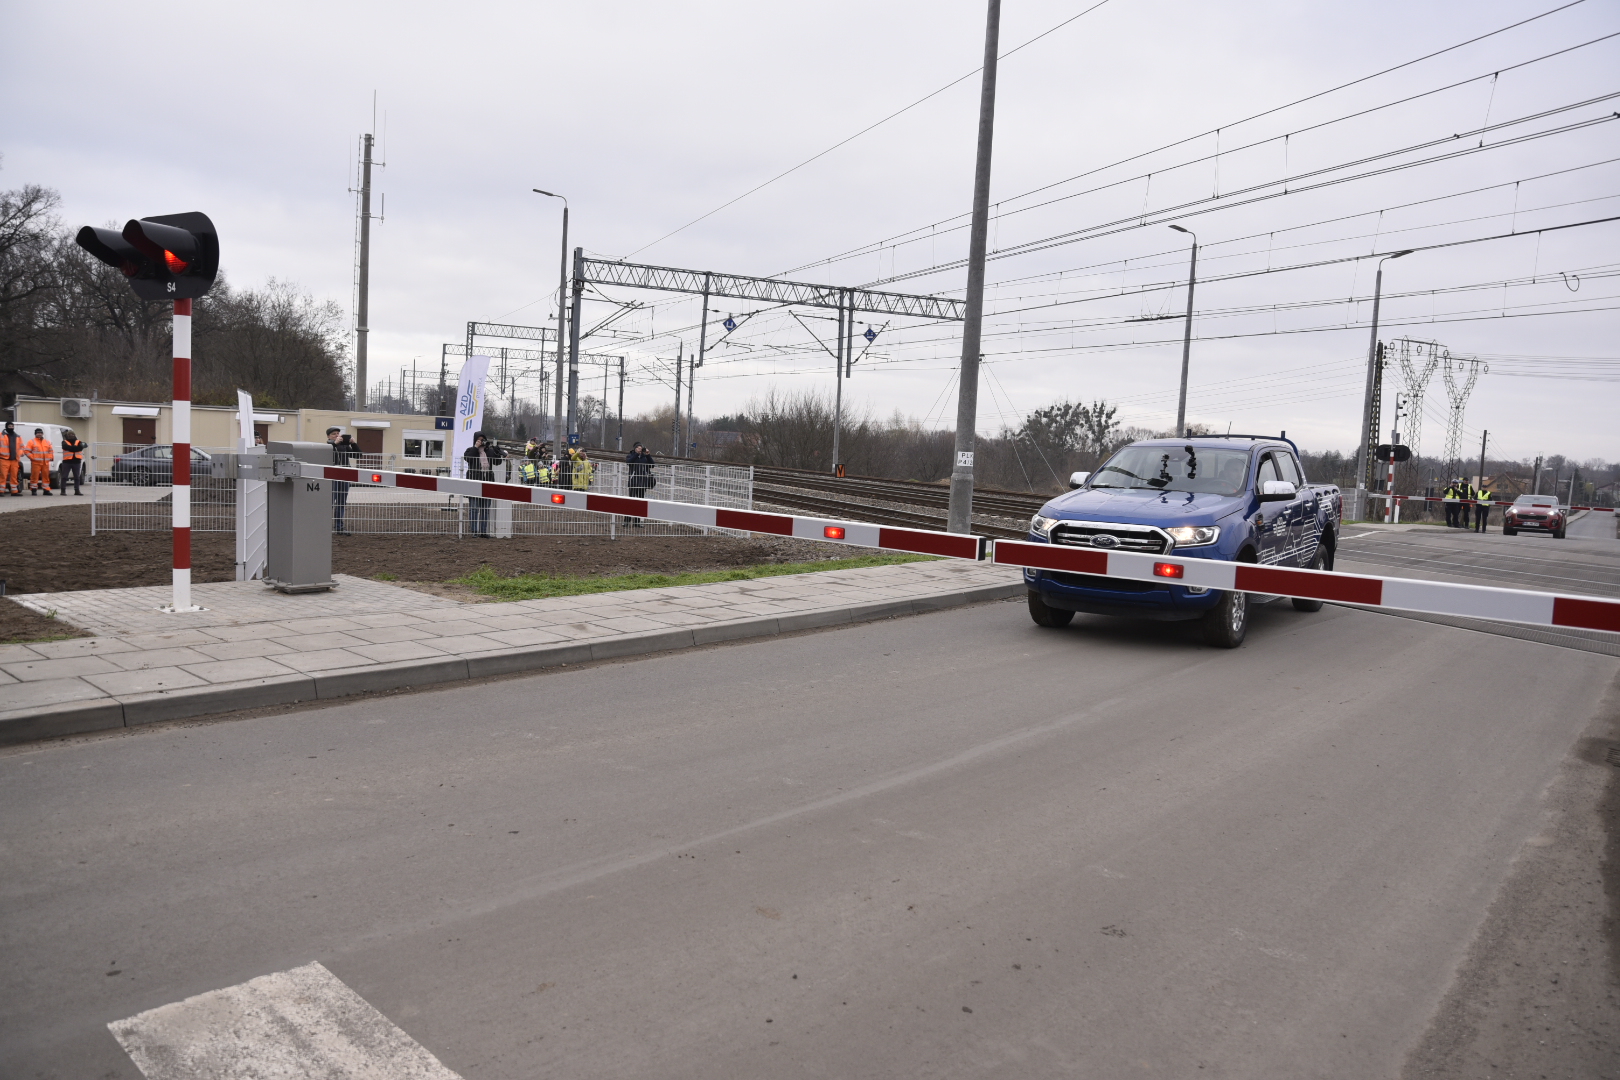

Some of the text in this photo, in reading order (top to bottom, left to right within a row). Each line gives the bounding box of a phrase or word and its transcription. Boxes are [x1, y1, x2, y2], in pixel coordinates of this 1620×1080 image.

[167, 281, 176, 292] S4
[460, 395, 469, 416] AZD
[306, 482, 320, 492] N4
